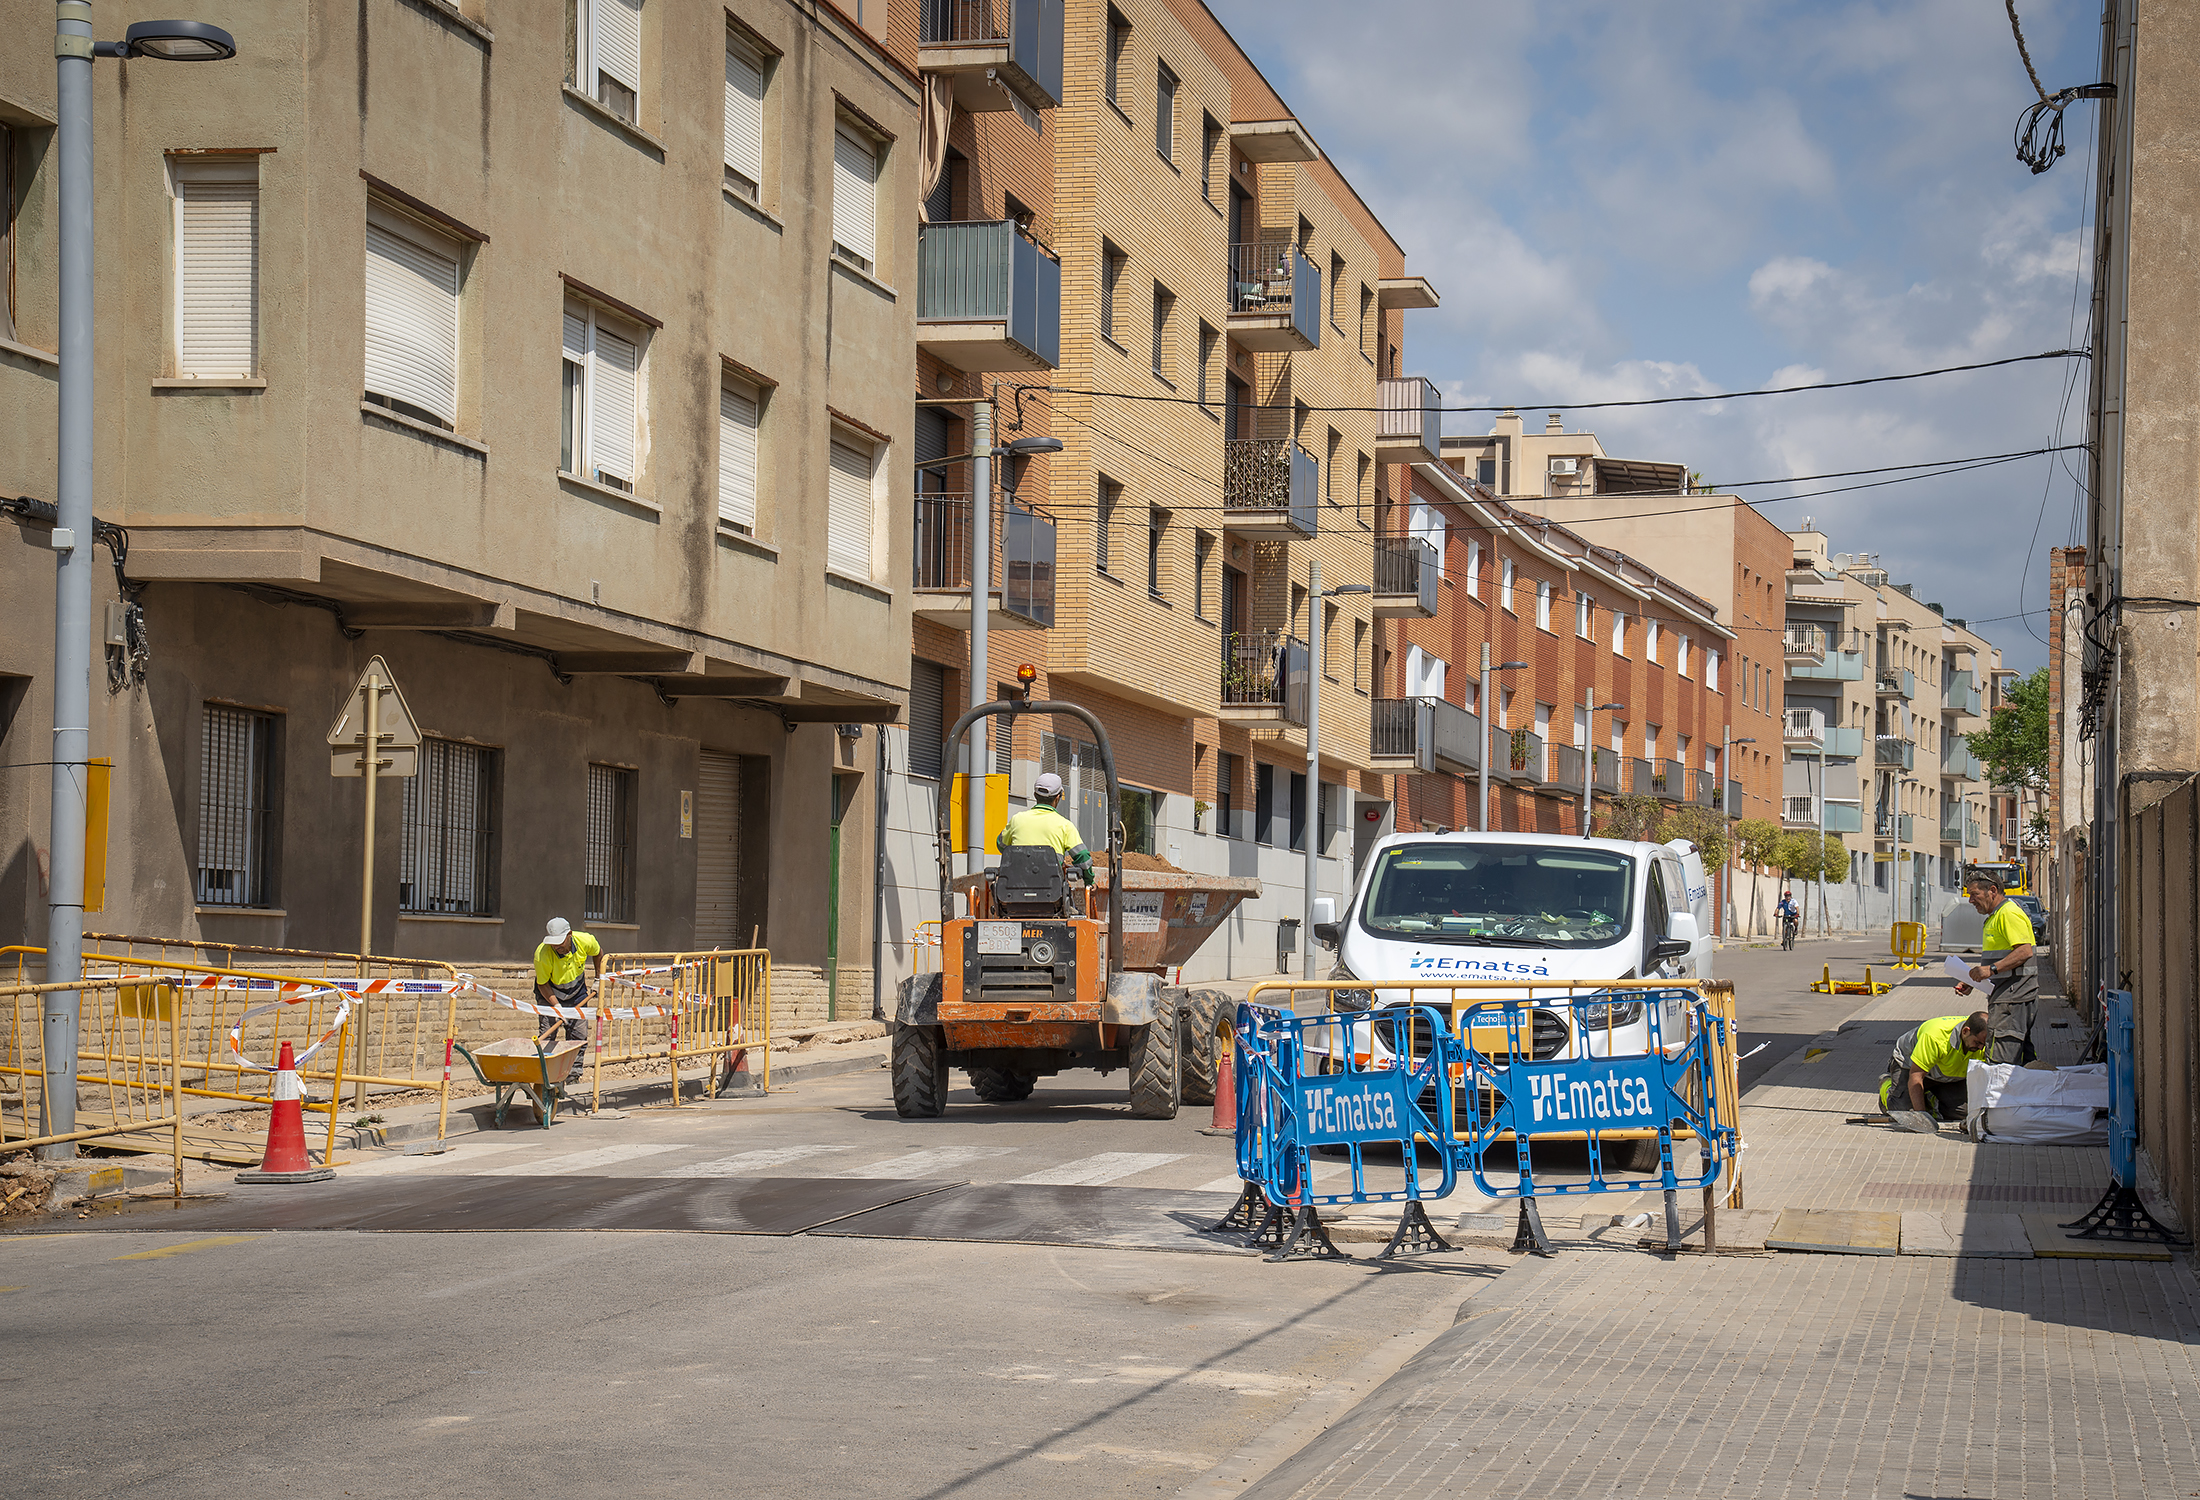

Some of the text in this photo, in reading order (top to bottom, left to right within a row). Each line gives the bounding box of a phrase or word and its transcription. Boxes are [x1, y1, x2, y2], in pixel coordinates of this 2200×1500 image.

[992, 925, 1017, 937] 5503
[988, 939, 1011, 950] BDR
[1437, 958, 1549, 976] Ematsa
[1477, 1015, 1498, 1023] Tecno
[1553, 1069, 1652, 1120] Ematsa
[1323, 1084, 1397, 1133] Ematsa
